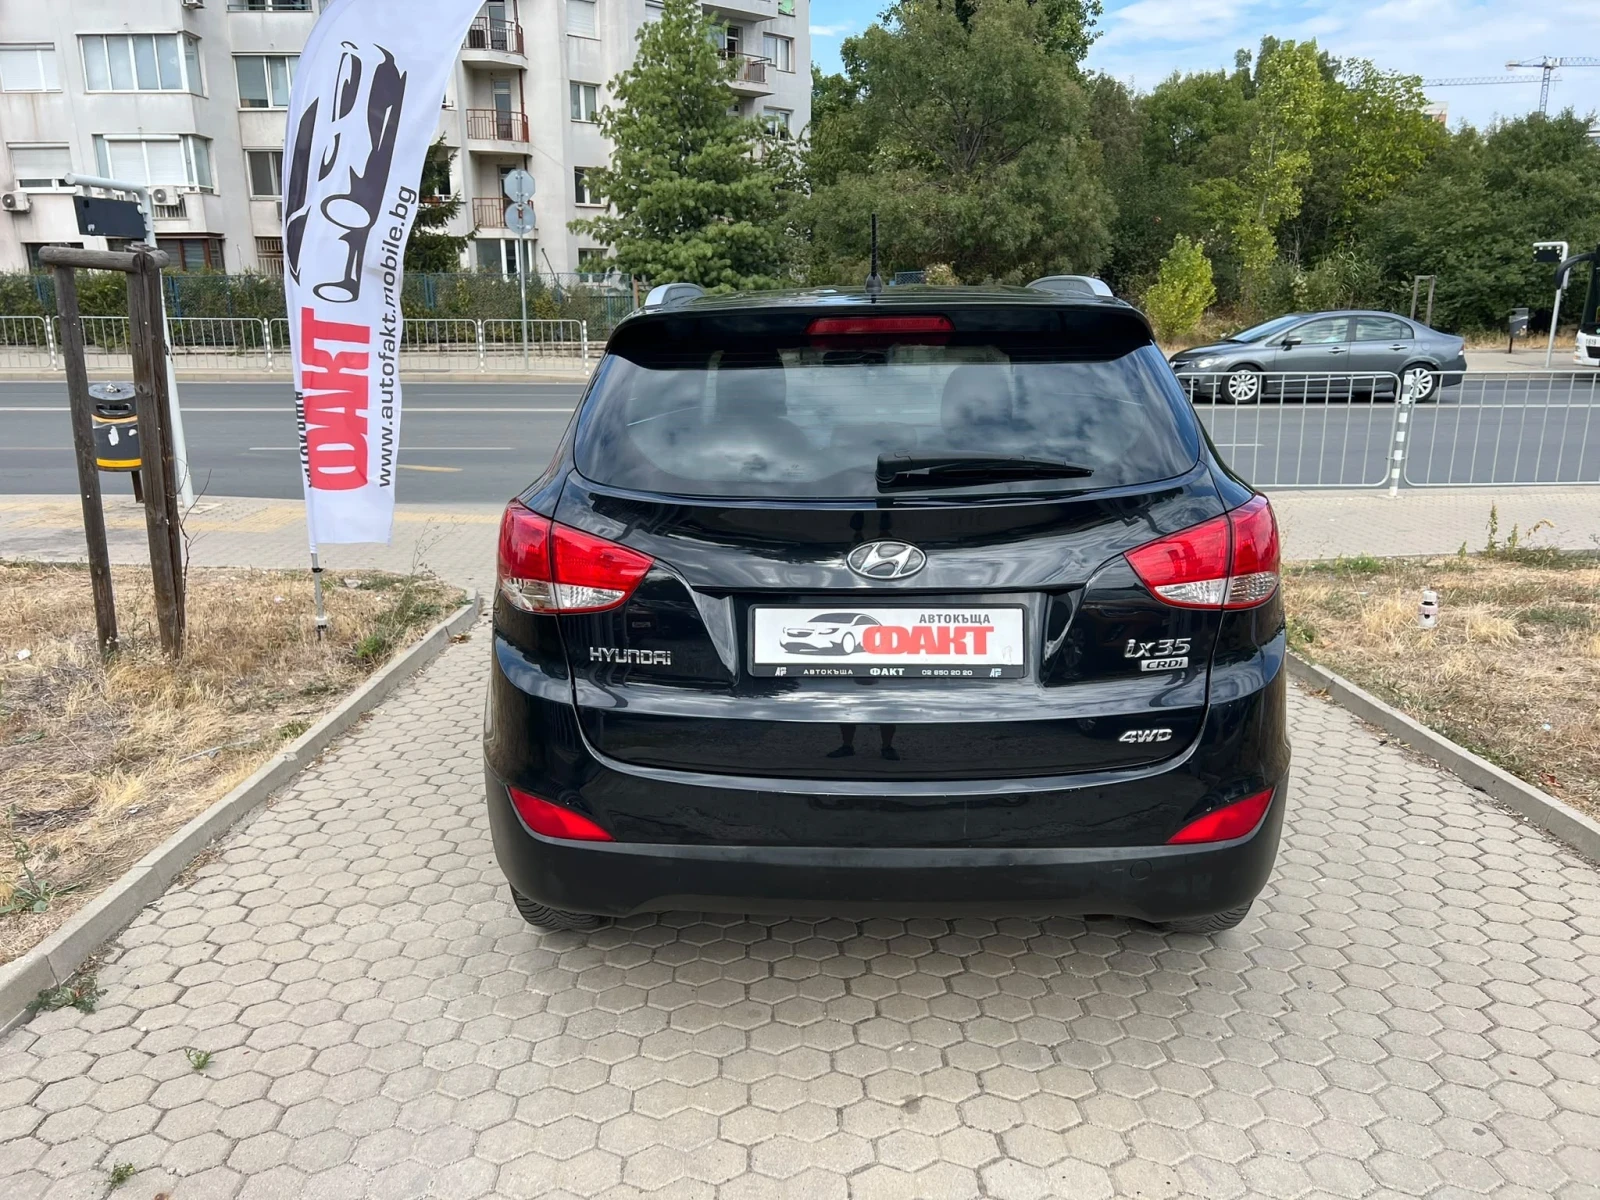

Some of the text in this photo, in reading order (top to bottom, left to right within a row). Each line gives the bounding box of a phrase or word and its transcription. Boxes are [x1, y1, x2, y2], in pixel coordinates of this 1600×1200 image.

[379, 185, 417, 488] www.autofakt.mobile.bg
[301, 306, 370, 491] ФАКТ
[919, 613, 991, 626] АВТОКЪЩА
[862, 626, 994, 655] ФАКТ
[589, 646, 671, 665] HYUNDAI
[1146, 659, 1184, 669] CRDi
[869, 667, 905, 676] ФАКТ
[1118, 728, 1173, 743] 4WD
